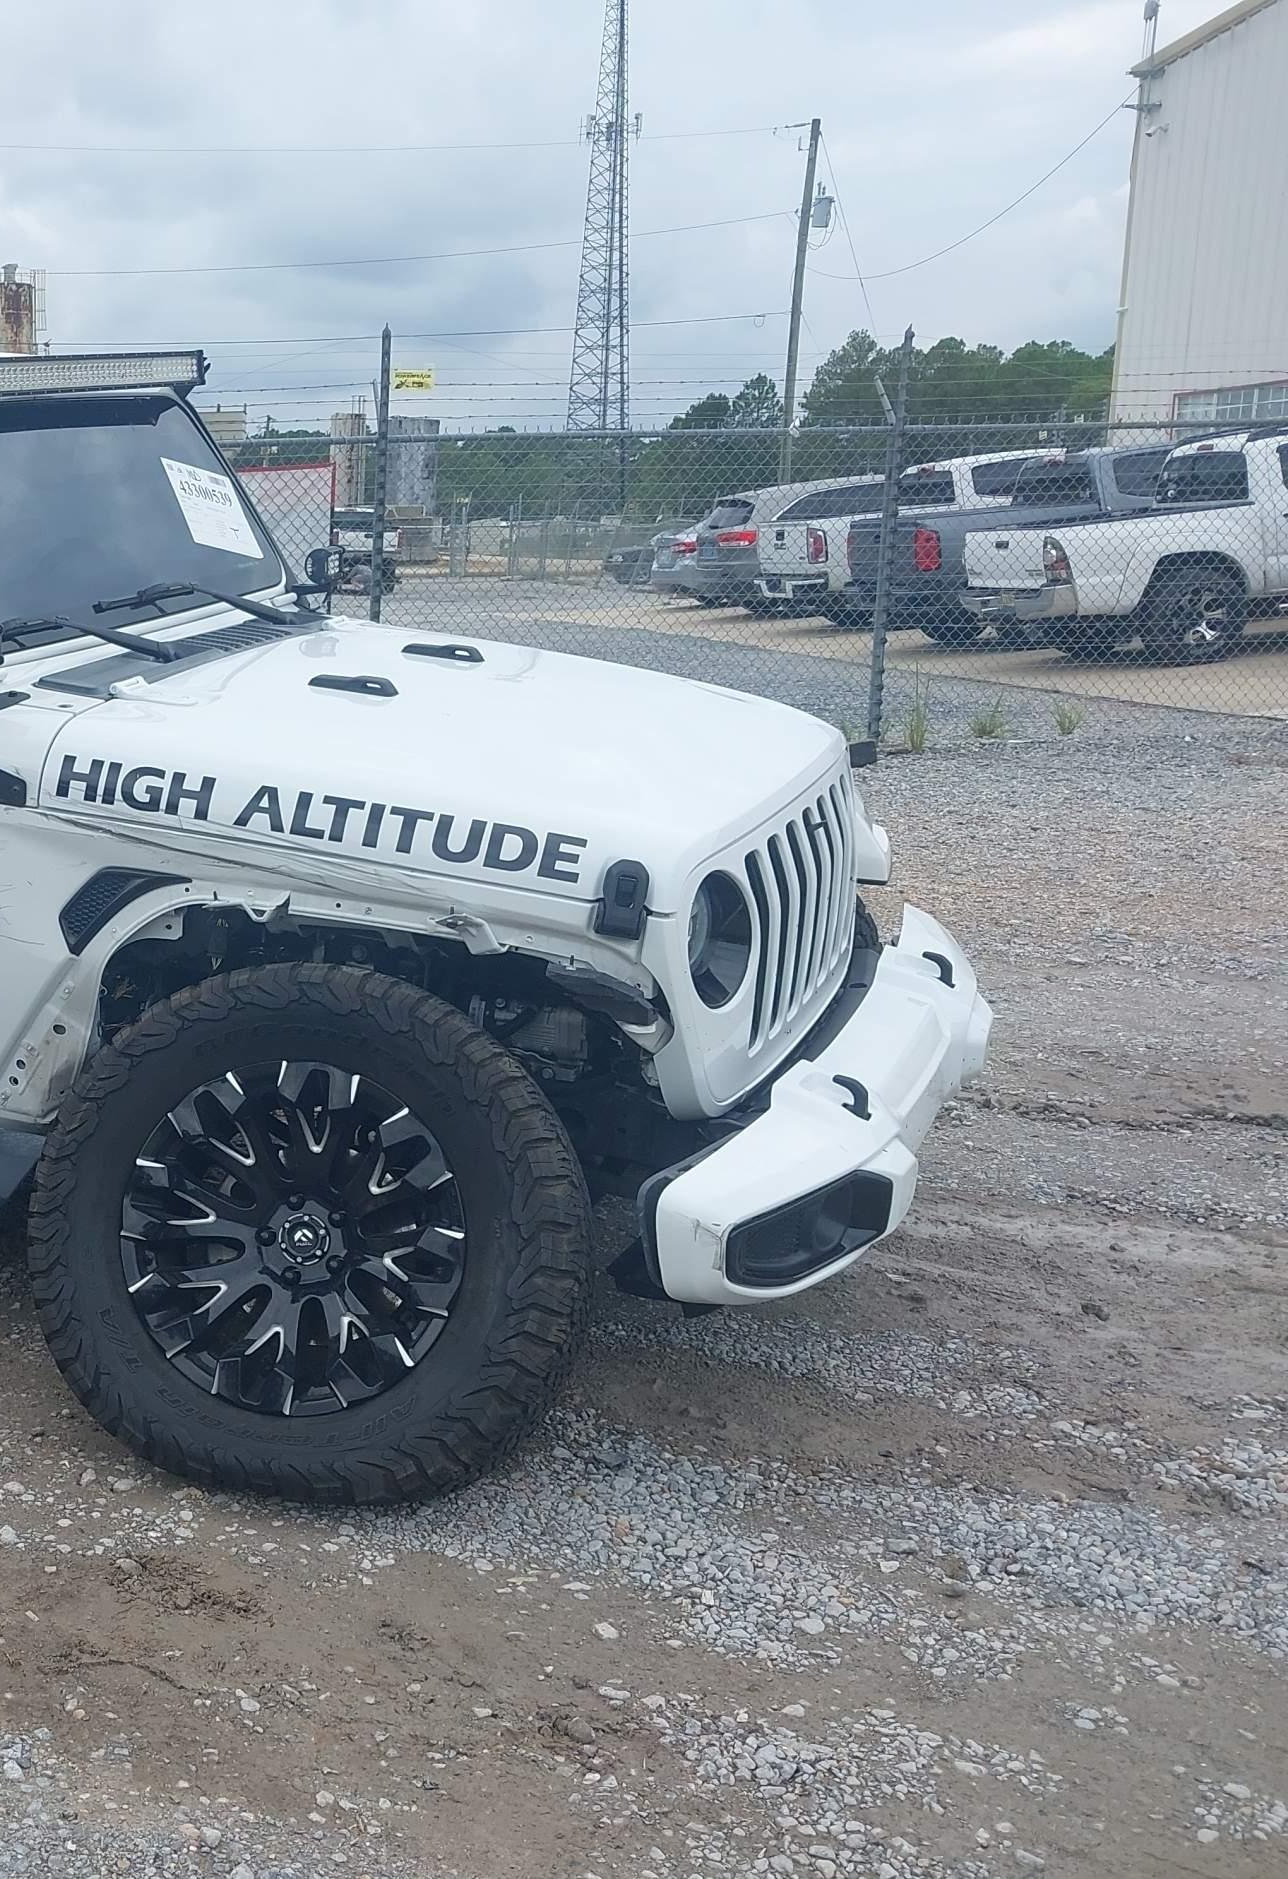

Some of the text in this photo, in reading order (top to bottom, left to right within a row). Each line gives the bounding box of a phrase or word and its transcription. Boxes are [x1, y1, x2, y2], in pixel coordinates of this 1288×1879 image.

[179, 480, 233, 507] 43300539
[56, 755, 588, 884] HIGH ALTITUDE
